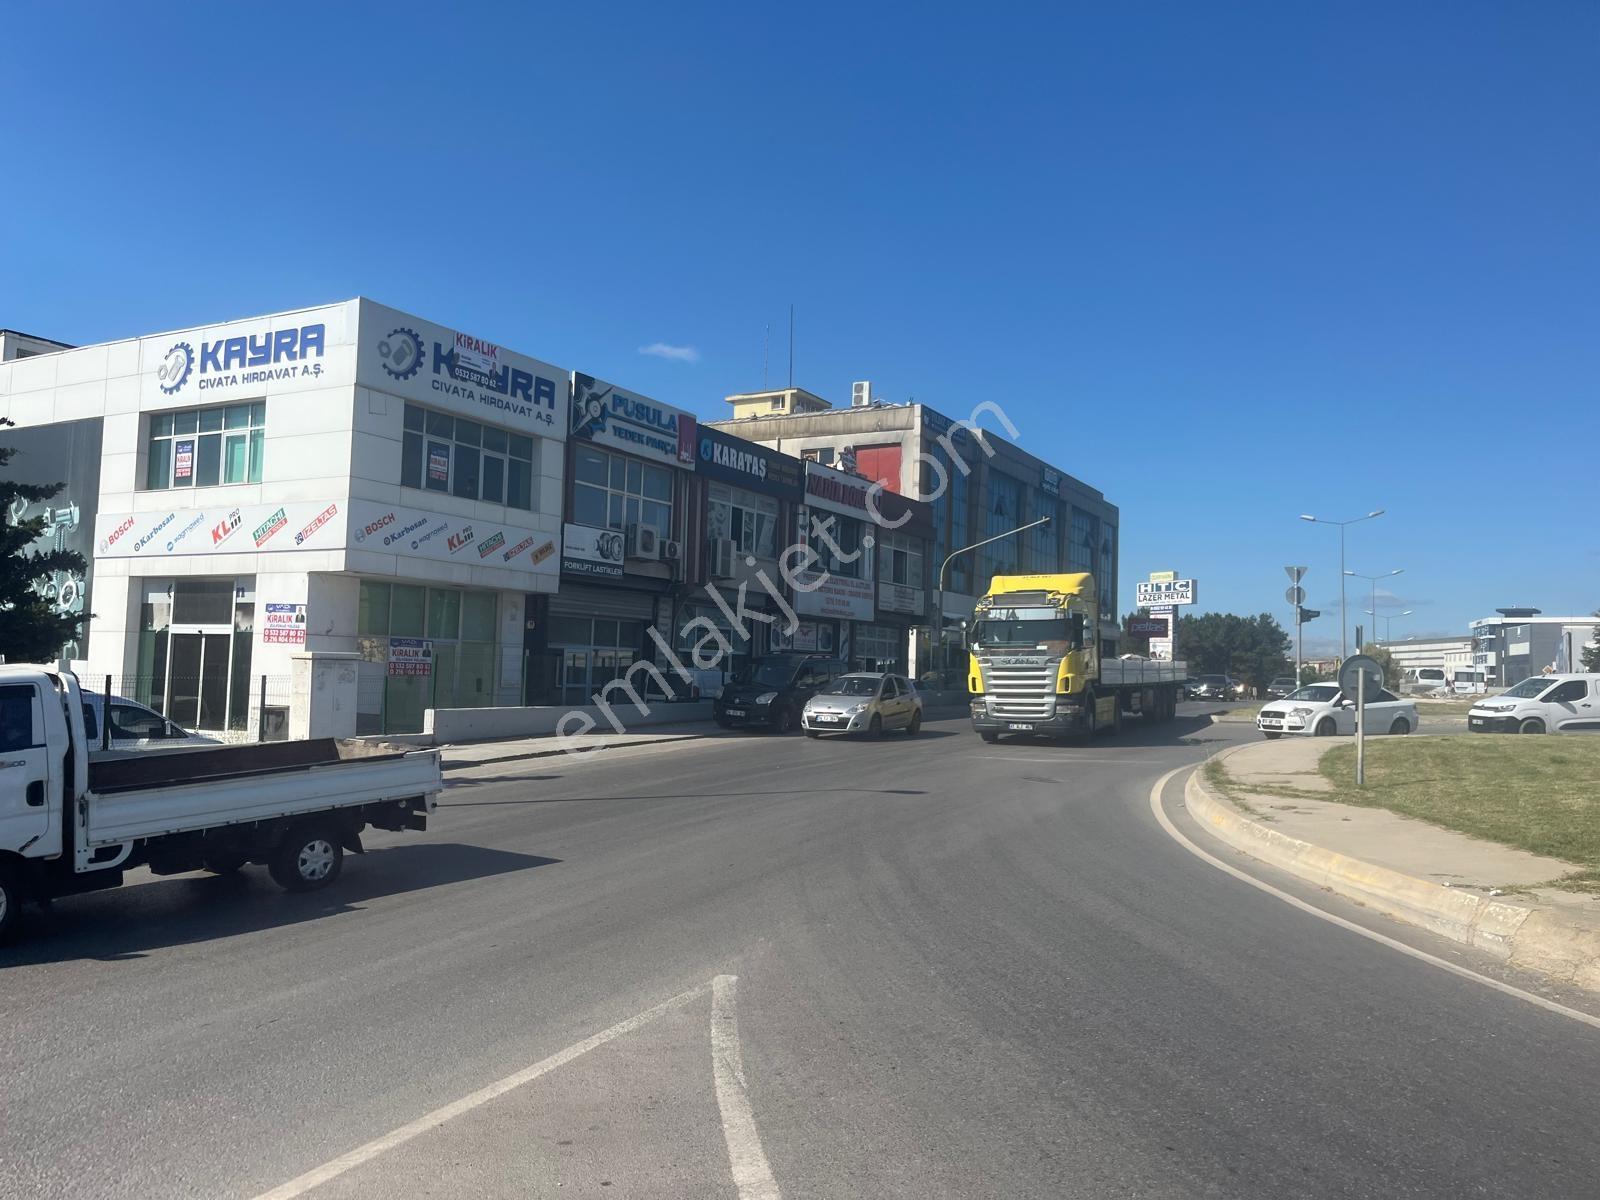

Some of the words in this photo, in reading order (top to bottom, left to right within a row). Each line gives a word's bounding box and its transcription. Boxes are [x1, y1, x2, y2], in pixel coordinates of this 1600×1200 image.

[200, 323, 325, 374] KAYRA
[199, 375, 238, 390] CIVATA
[242, 367, 298, 385] HIRDAVAT
[301, 363, 324, 379] A.Ş.
[431, 379, 475, 401] CIVATA
[479, 393, 532, 417] HIRDAVAT
[535, 410, 555, 427] A.Ş.
[612, 394, 677, 432] PUSULA
[612, 424, 644, 445] YEDEK
[646, 435, 677, 455] PARÇA
[713, 442, 767, 482] KARATAŞ
[108, 516, 135, 545] BOSCH
[140, 512, 175, 547] Karbosan
[254, 509, 284, 539] HITACHI
[365, 512, 395, 536] BOSCH
[390, 518, 428, 542] Karbosan
[1138, 594, 1163, 602] LAZER
[1164, 592, 1190, 600] METAL
